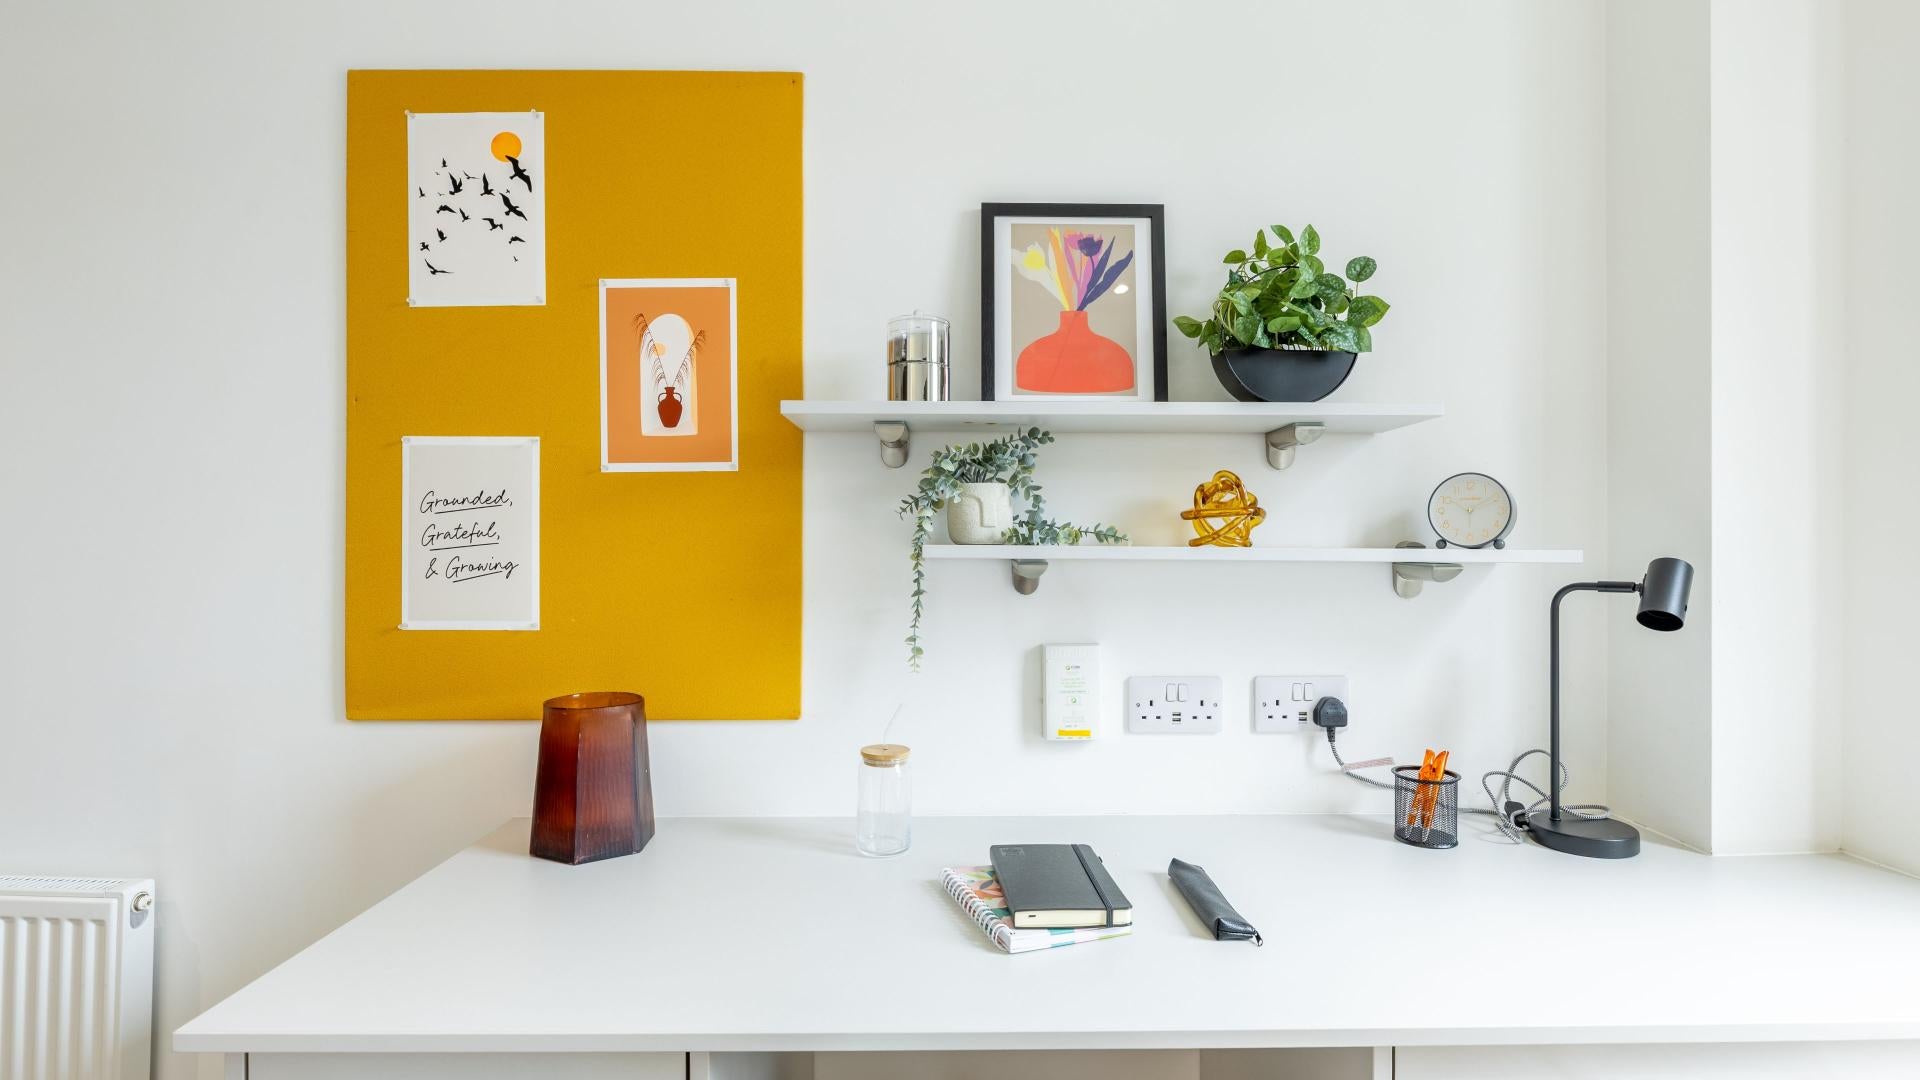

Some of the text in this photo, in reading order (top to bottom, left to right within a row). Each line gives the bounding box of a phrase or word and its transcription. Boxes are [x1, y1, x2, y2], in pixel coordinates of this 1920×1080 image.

[420, 489, 513, 514] Grounded,
[421, 521, 500, 547] Grateful,
[425, 555, 519, 579] & Growing
